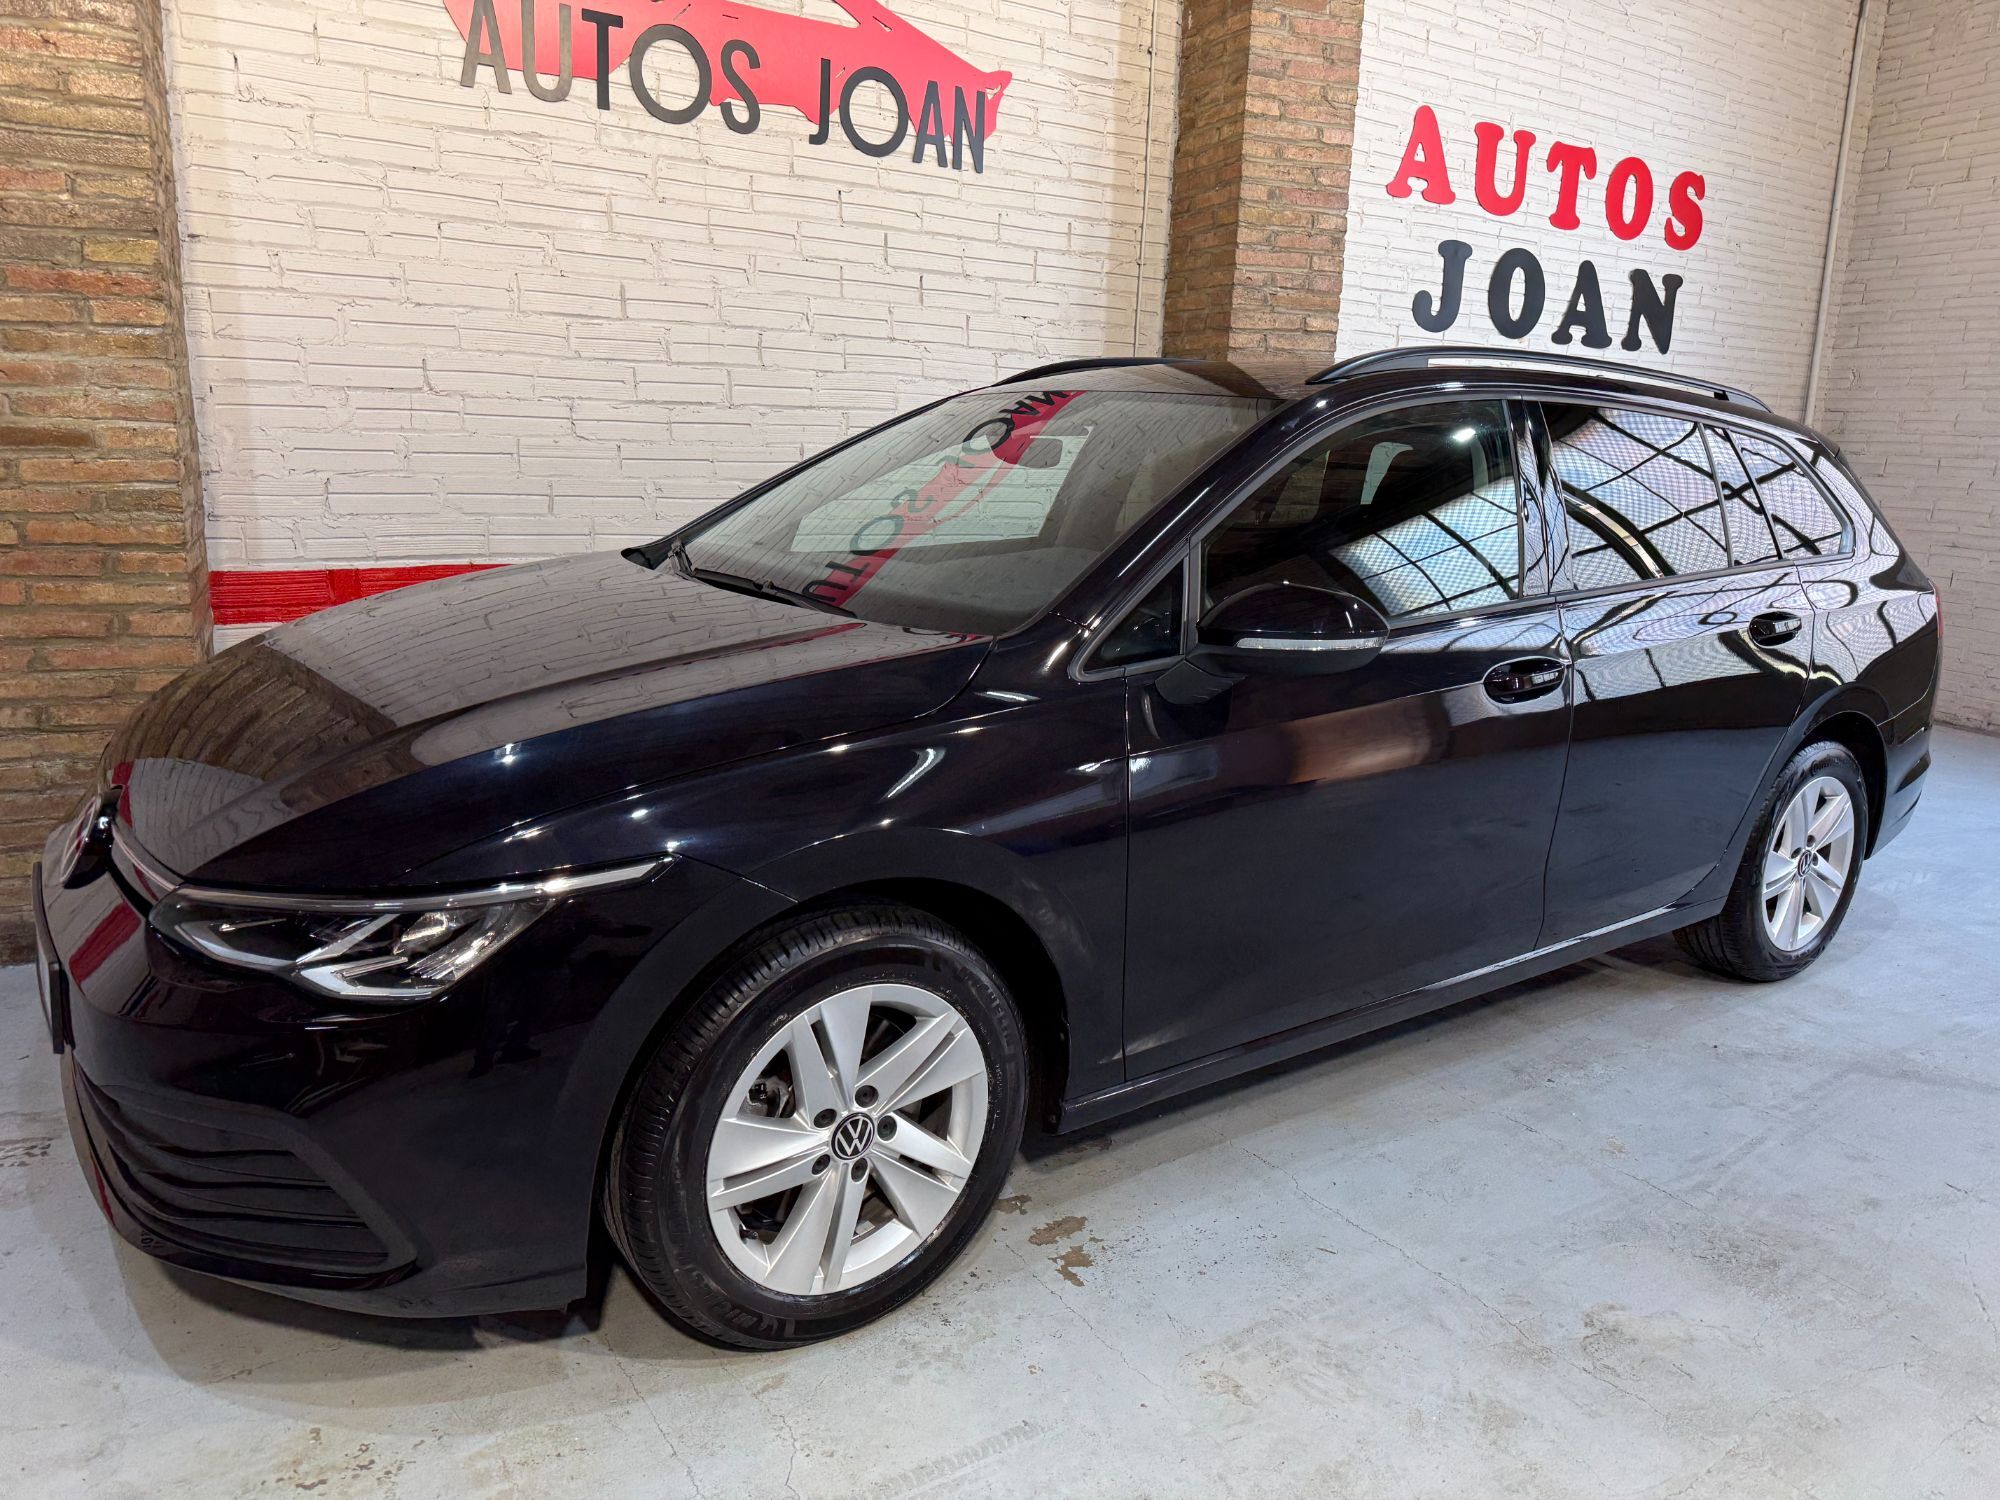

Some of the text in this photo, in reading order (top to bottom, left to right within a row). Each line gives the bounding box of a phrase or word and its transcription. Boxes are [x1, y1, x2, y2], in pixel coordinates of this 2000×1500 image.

[460, 0, 986, 174] AUTOS JOAN
[1386, 105, 1706, 251] AUTOS
[1411, 239, 1684, 355] JOAN
